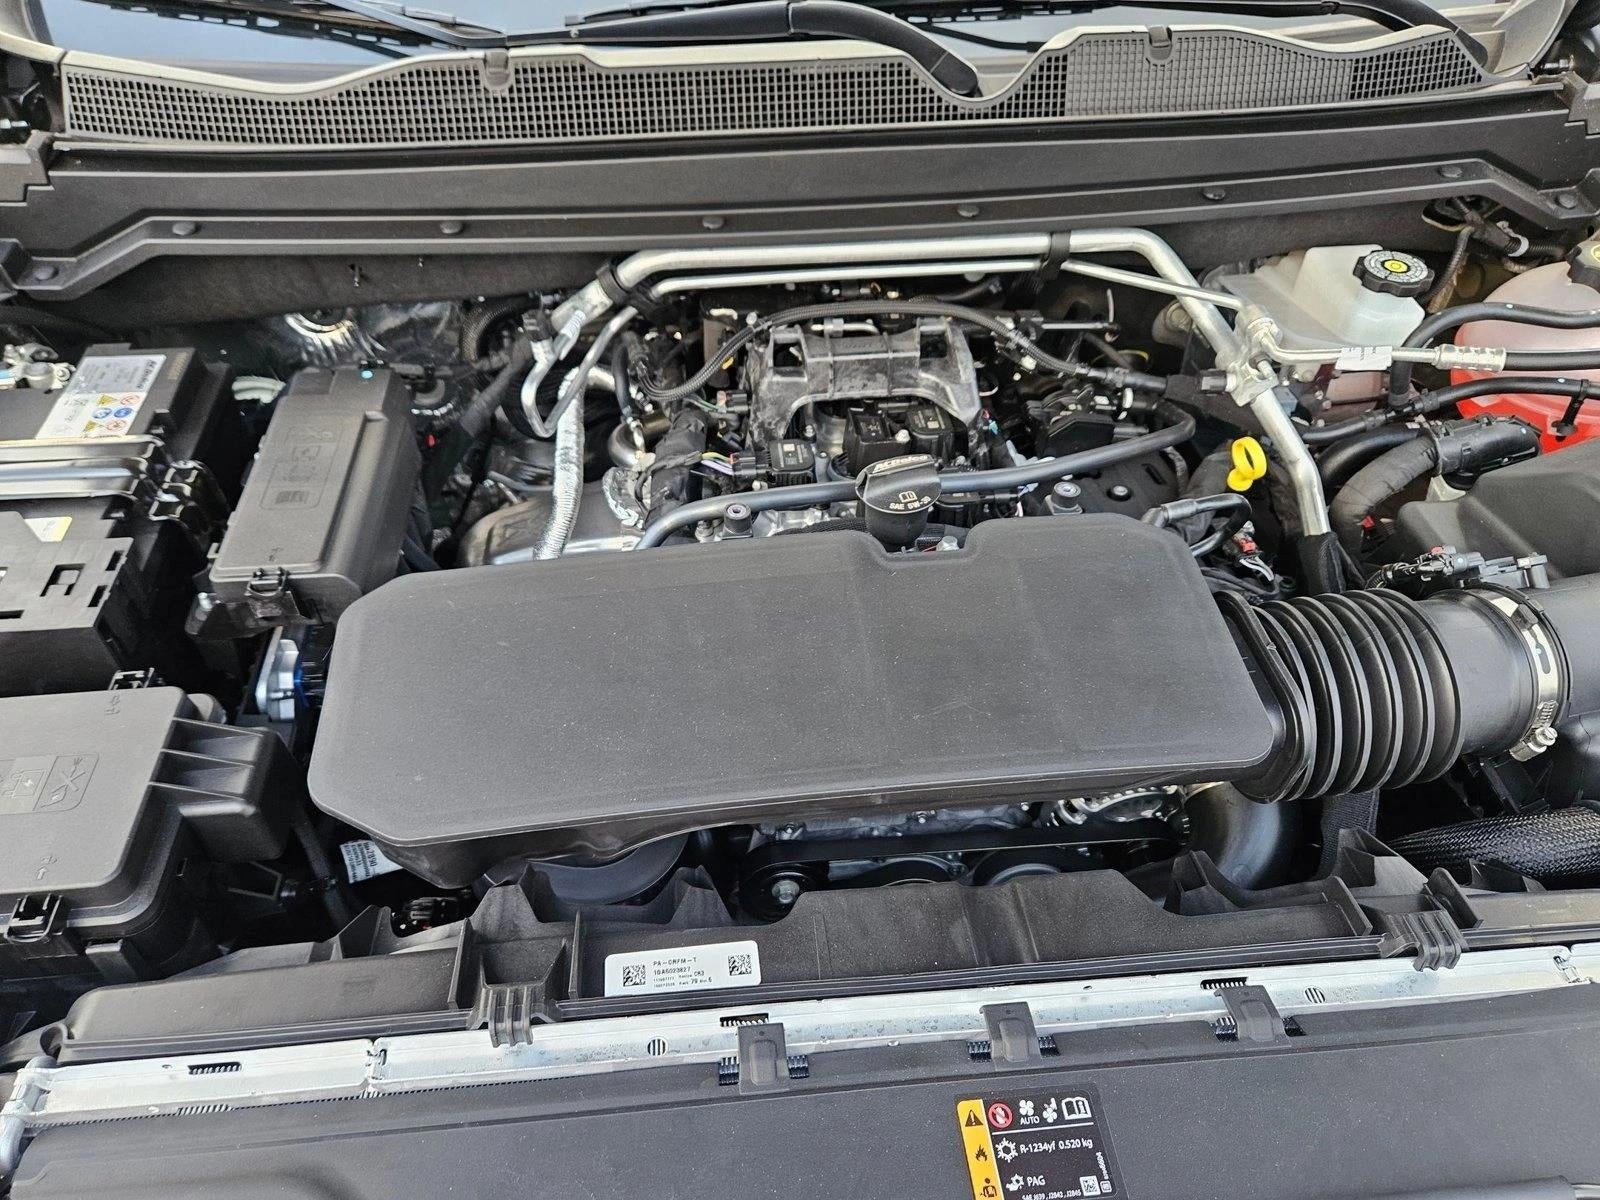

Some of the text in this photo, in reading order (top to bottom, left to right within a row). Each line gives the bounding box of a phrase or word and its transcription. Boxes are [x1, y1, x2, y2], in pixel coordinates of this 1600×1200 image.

[889, 502, 905, 510] SAE
[1020, 1116, 1040, 1126] AUTO
[1019, 1137, 1094, 1154] R-1234yf 0.520 kg
[1026, 1175, 1046, 1187] PAG
